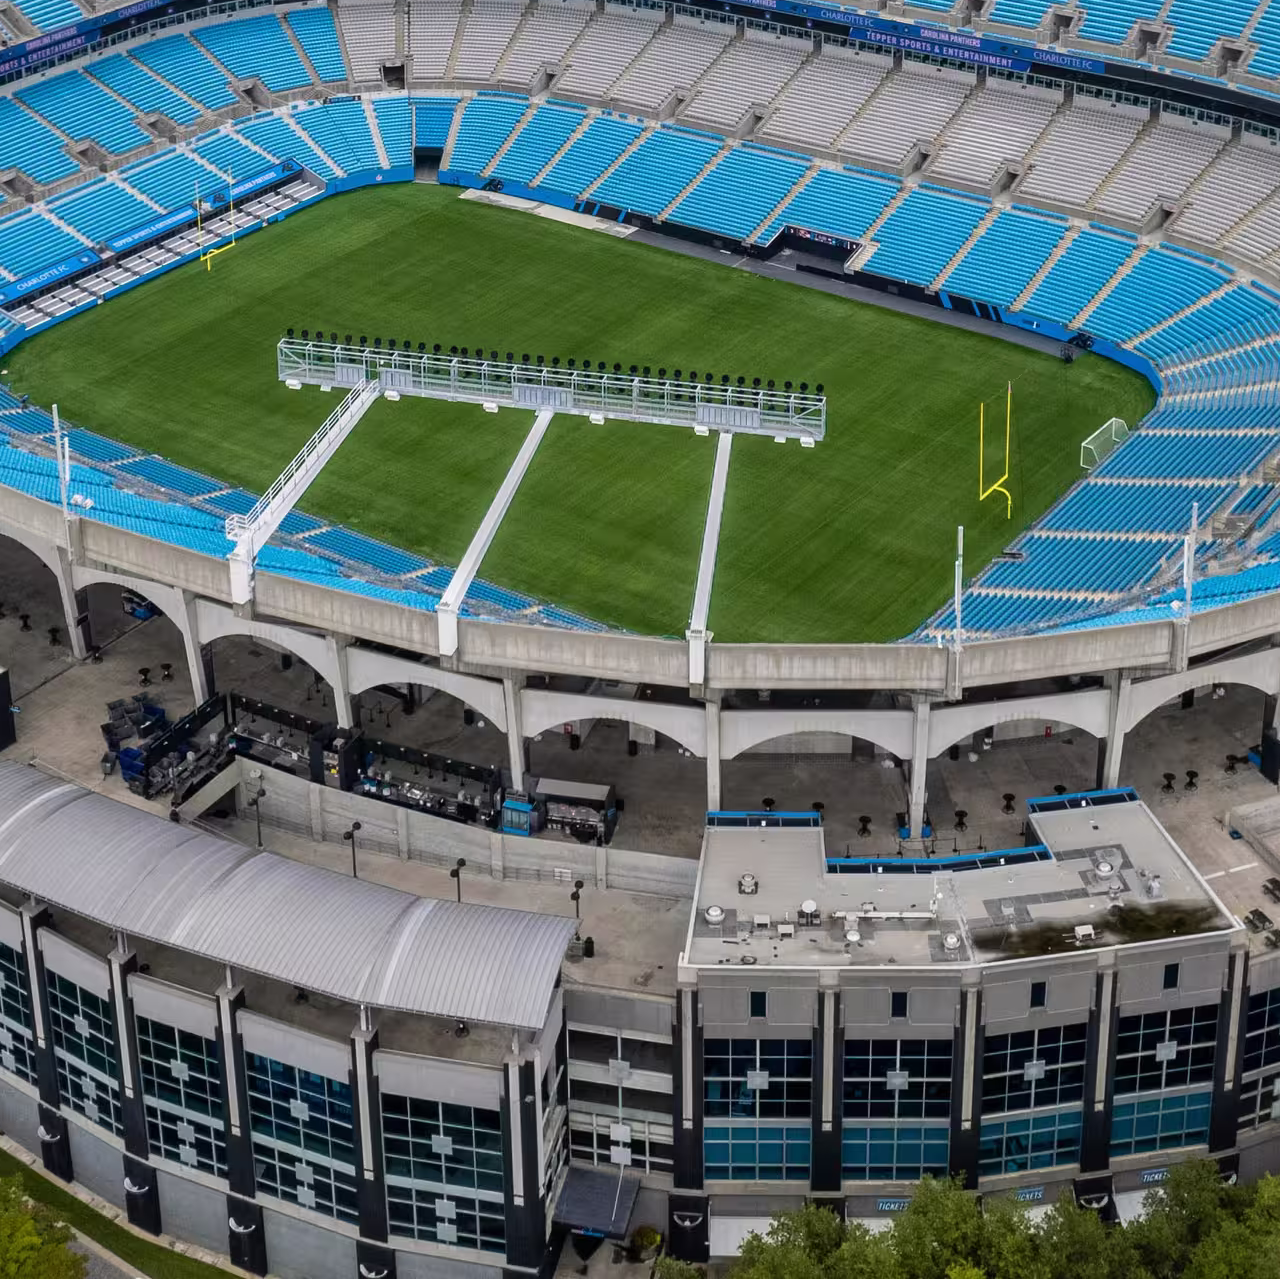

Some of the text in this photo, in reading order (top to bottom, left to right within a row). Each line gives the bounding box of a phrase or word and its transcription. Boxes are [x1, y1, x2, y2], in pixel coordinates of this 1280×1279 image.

[821, 10, 875, 27] CHARLOTTE FC
[20, 55, 26, 66] &
[28, 35, 86, 63] ENTERTAINMENT
[866, 32, 1013, 68] TEPPER SPORTS & ENTERTAINMENT
[1033, 51, 1092, 70] CHARLOTTE FC
[16, 264, 69, 291] CHARLOTTE FC
[1143, 1172, 1171, 1183] TICKET
